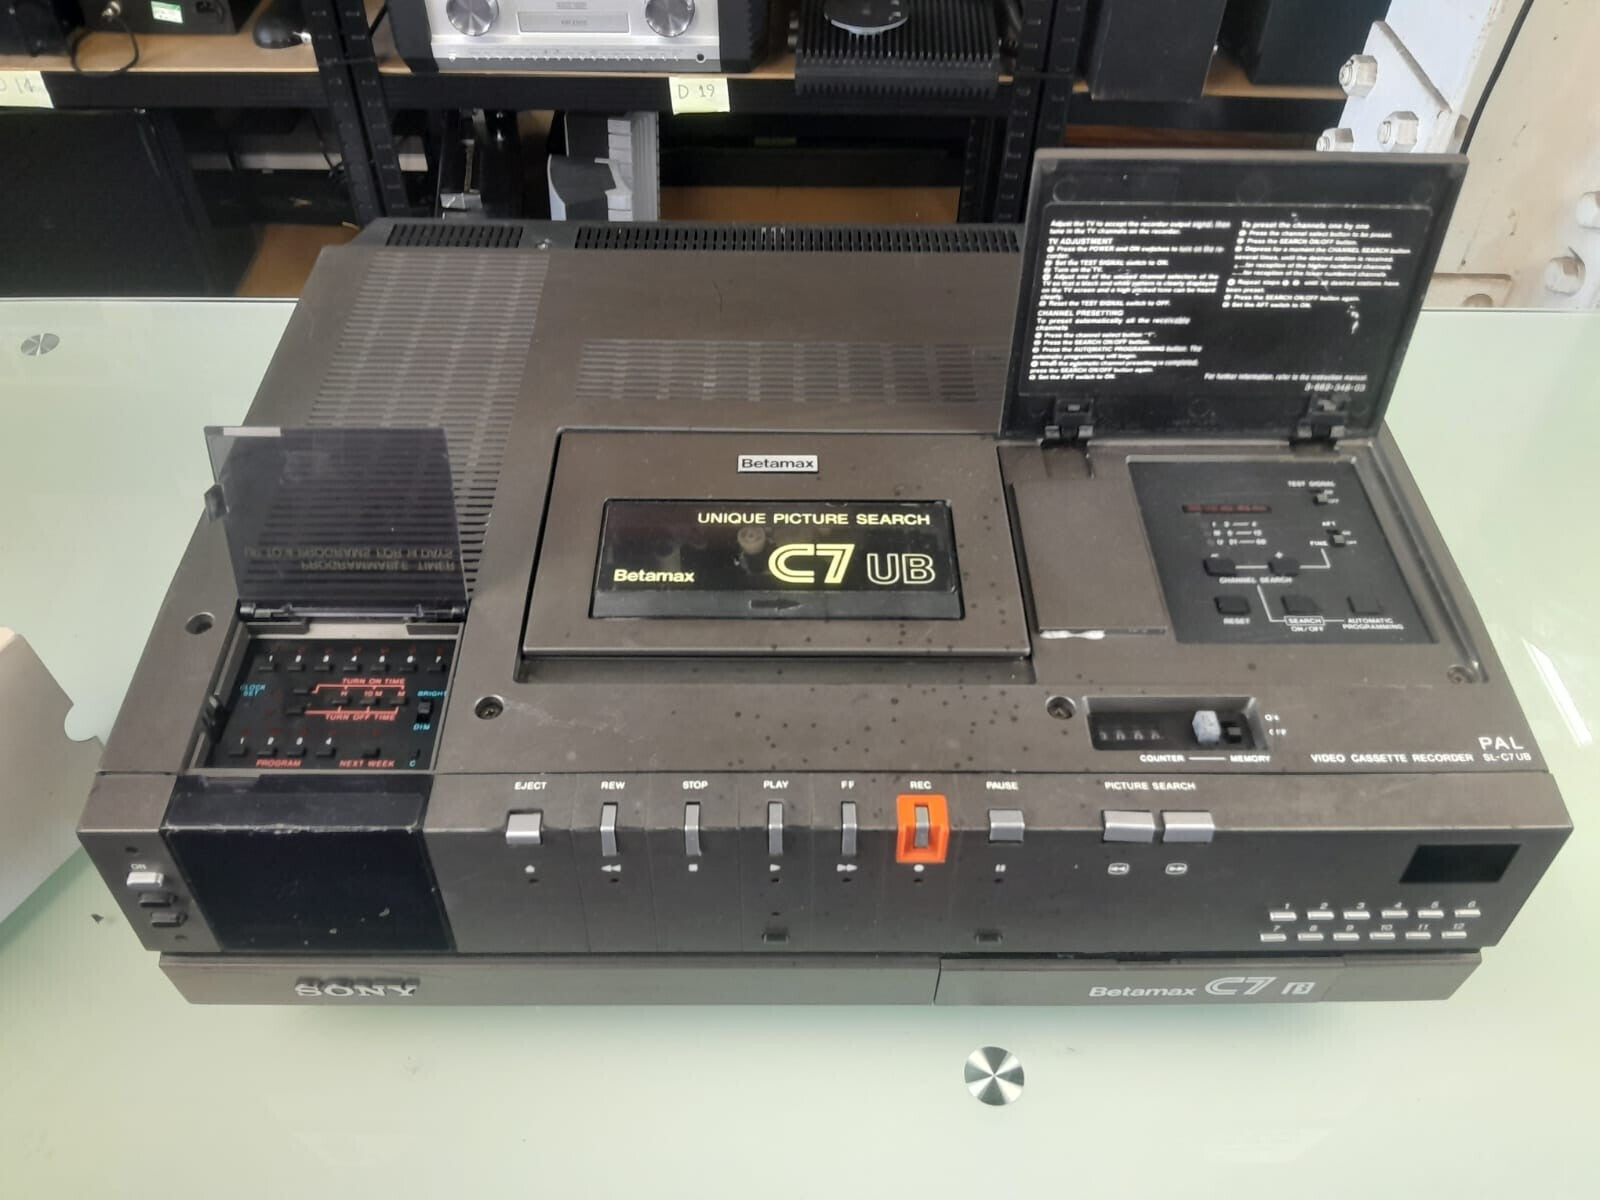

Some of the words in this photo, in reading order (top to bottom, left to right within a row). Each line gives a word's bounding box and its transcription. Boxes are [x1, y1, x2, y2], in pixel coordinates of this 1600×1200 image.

[677, 84, 689, 100] D
[698, 83, 715, 98] 19
[741, 458, 814, 470] Betamax
[697, 512, 767, 526] UNIQUE
[773, 513, 849, 526] PICTURE
[856, 513, 931, 526] SEARCH
[613, 568, 695, 583] Betamax
[768, 543, 855, 584] C7
[866, 553, 937, 586] UB
[1219, 576, 1257, 584] CHANNEL
[1259, 576, 1293, 584] SEARCH
[325, 713, 349, 721] TURN
[352, 713, 371, 721] OFF
[373, 713, 396, 721] TIME
[1478, 736, 1524, 751] PAL
[256, 759, 302, 768] PROGRAM
[338, 759, 365, 768] NEXT
[367, 759, 395, 768] WEEK
[1139, 754, 1185, 763] COUNTER
[1230, 754, 1271, 763] MEMORY
[1310, 753, 1346, 764] VIDEO
[1350, 753, 1408, 764] CASSETTE
[1412, 753, 1474, 763] RECORDER
[514, 781, 547, 791] EJECT
[601, 781, 626, 791] REW
[682, 780, 708, 790] STOP
[763, 780, 789, 790] PLAY
[910, 781, 932, 790] REC
[986, 781, 1019, 791] PAUSE
[1104, 781, 1149, 791] PICTURE
[1152, 782, 1196, 791] SEARCH
[1319, 902, 1328, 910] 2
[1356, 902, 1365, 910] 3
[1430, 901, 1439, 909] 5
[1467, 901, 1477, 909] 6
[294, 983, 418, 997] SONY
[1088, 986, 1197, 998] Betamax
[1204, 976, 1278, 996] C7
